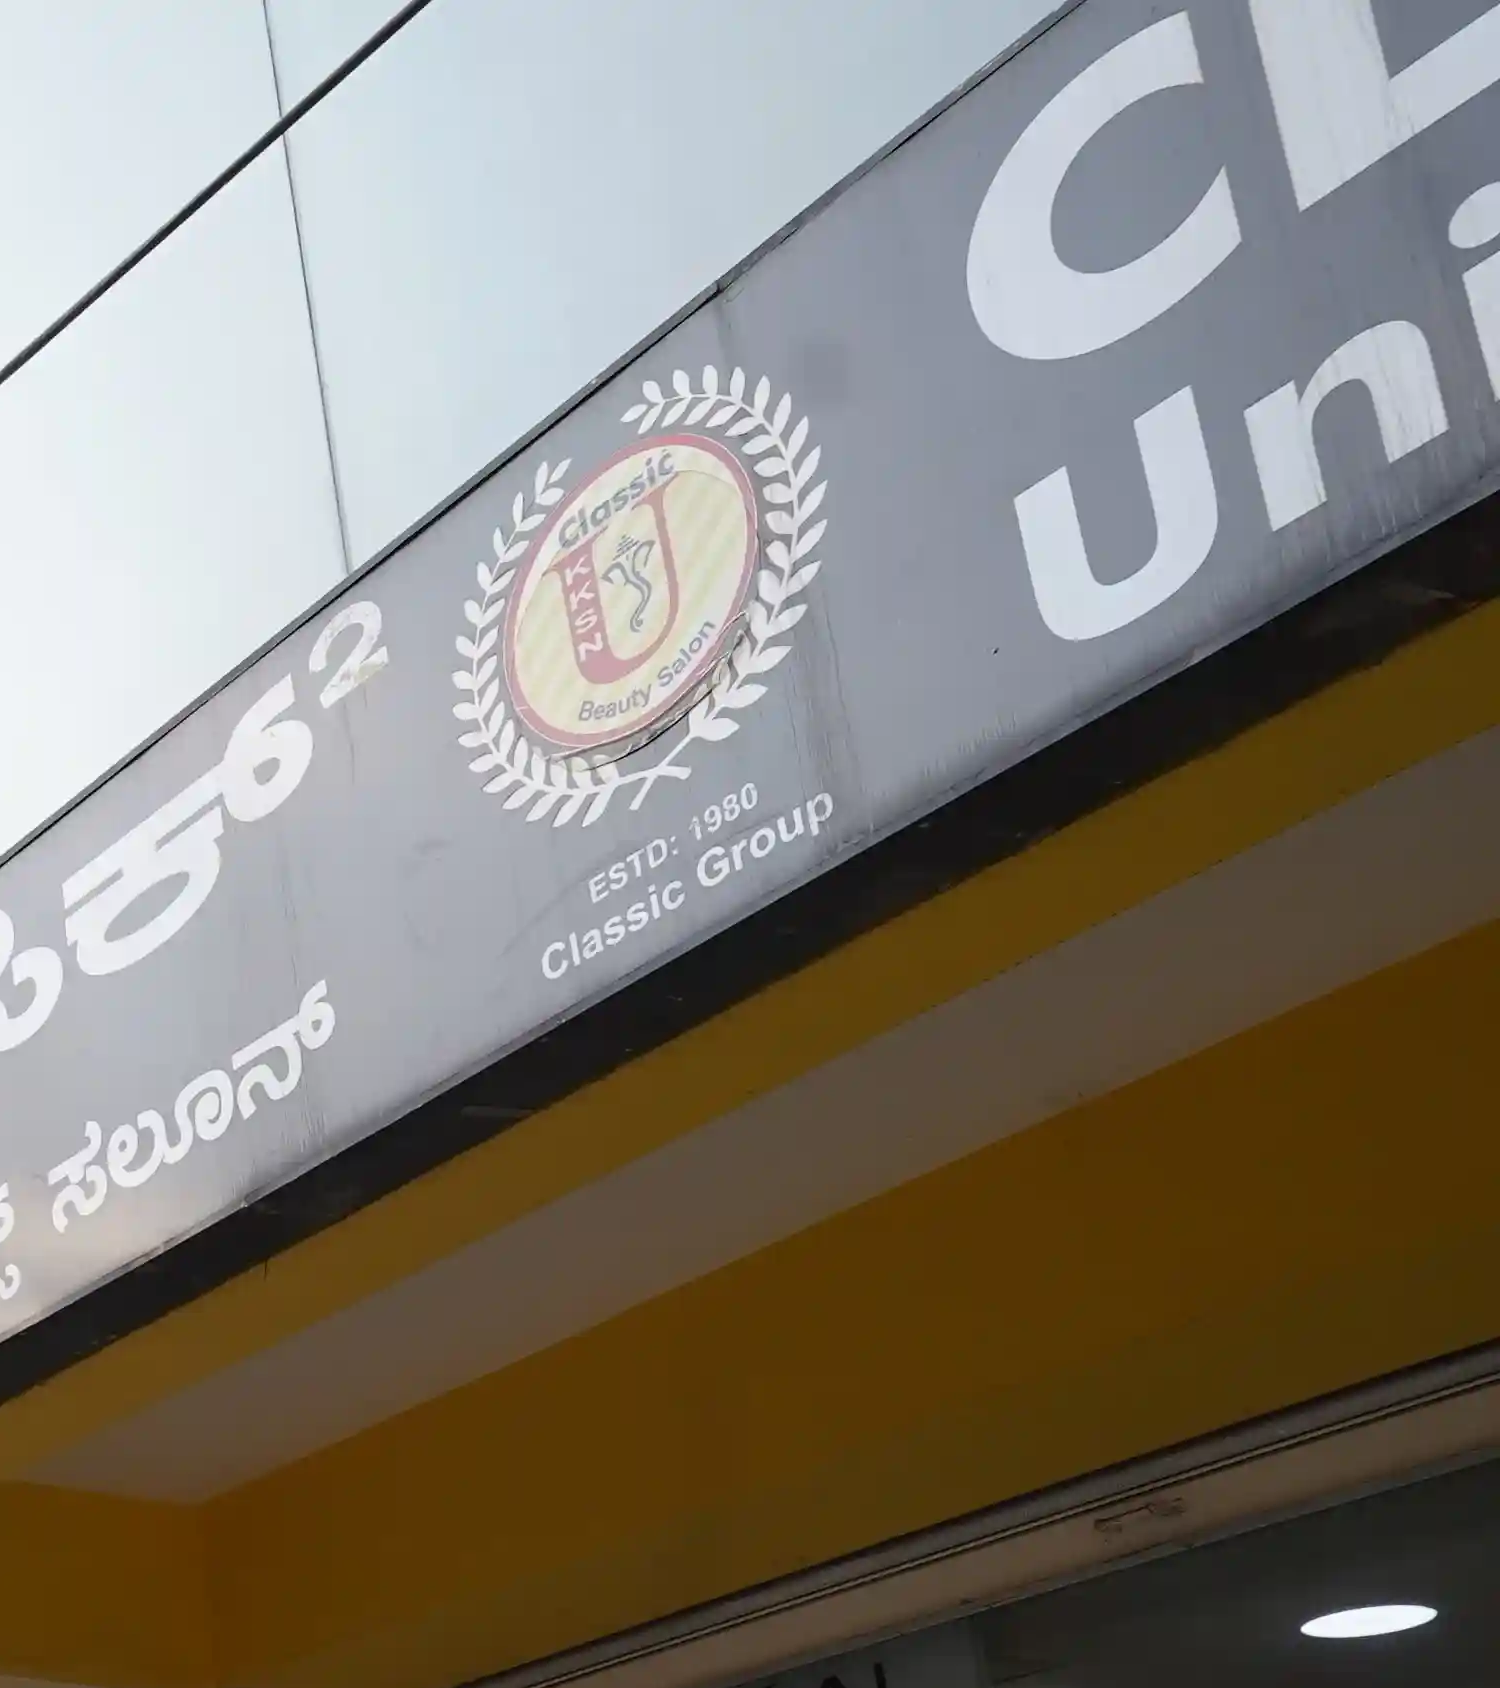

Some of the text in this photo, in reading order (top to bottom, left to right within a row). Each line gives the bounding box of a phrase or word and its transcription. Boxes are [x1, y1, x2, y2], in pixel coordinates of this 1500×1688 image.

[557, 449, 677, 551] Classic
[578, 620, 717, 722] Beauty Salon
[541, 791, 835, 980] Classic Group
[589, 782, 760, 904] ESTD: 1980
[47, 980, 335, 1234] ಸಲೂನ್
